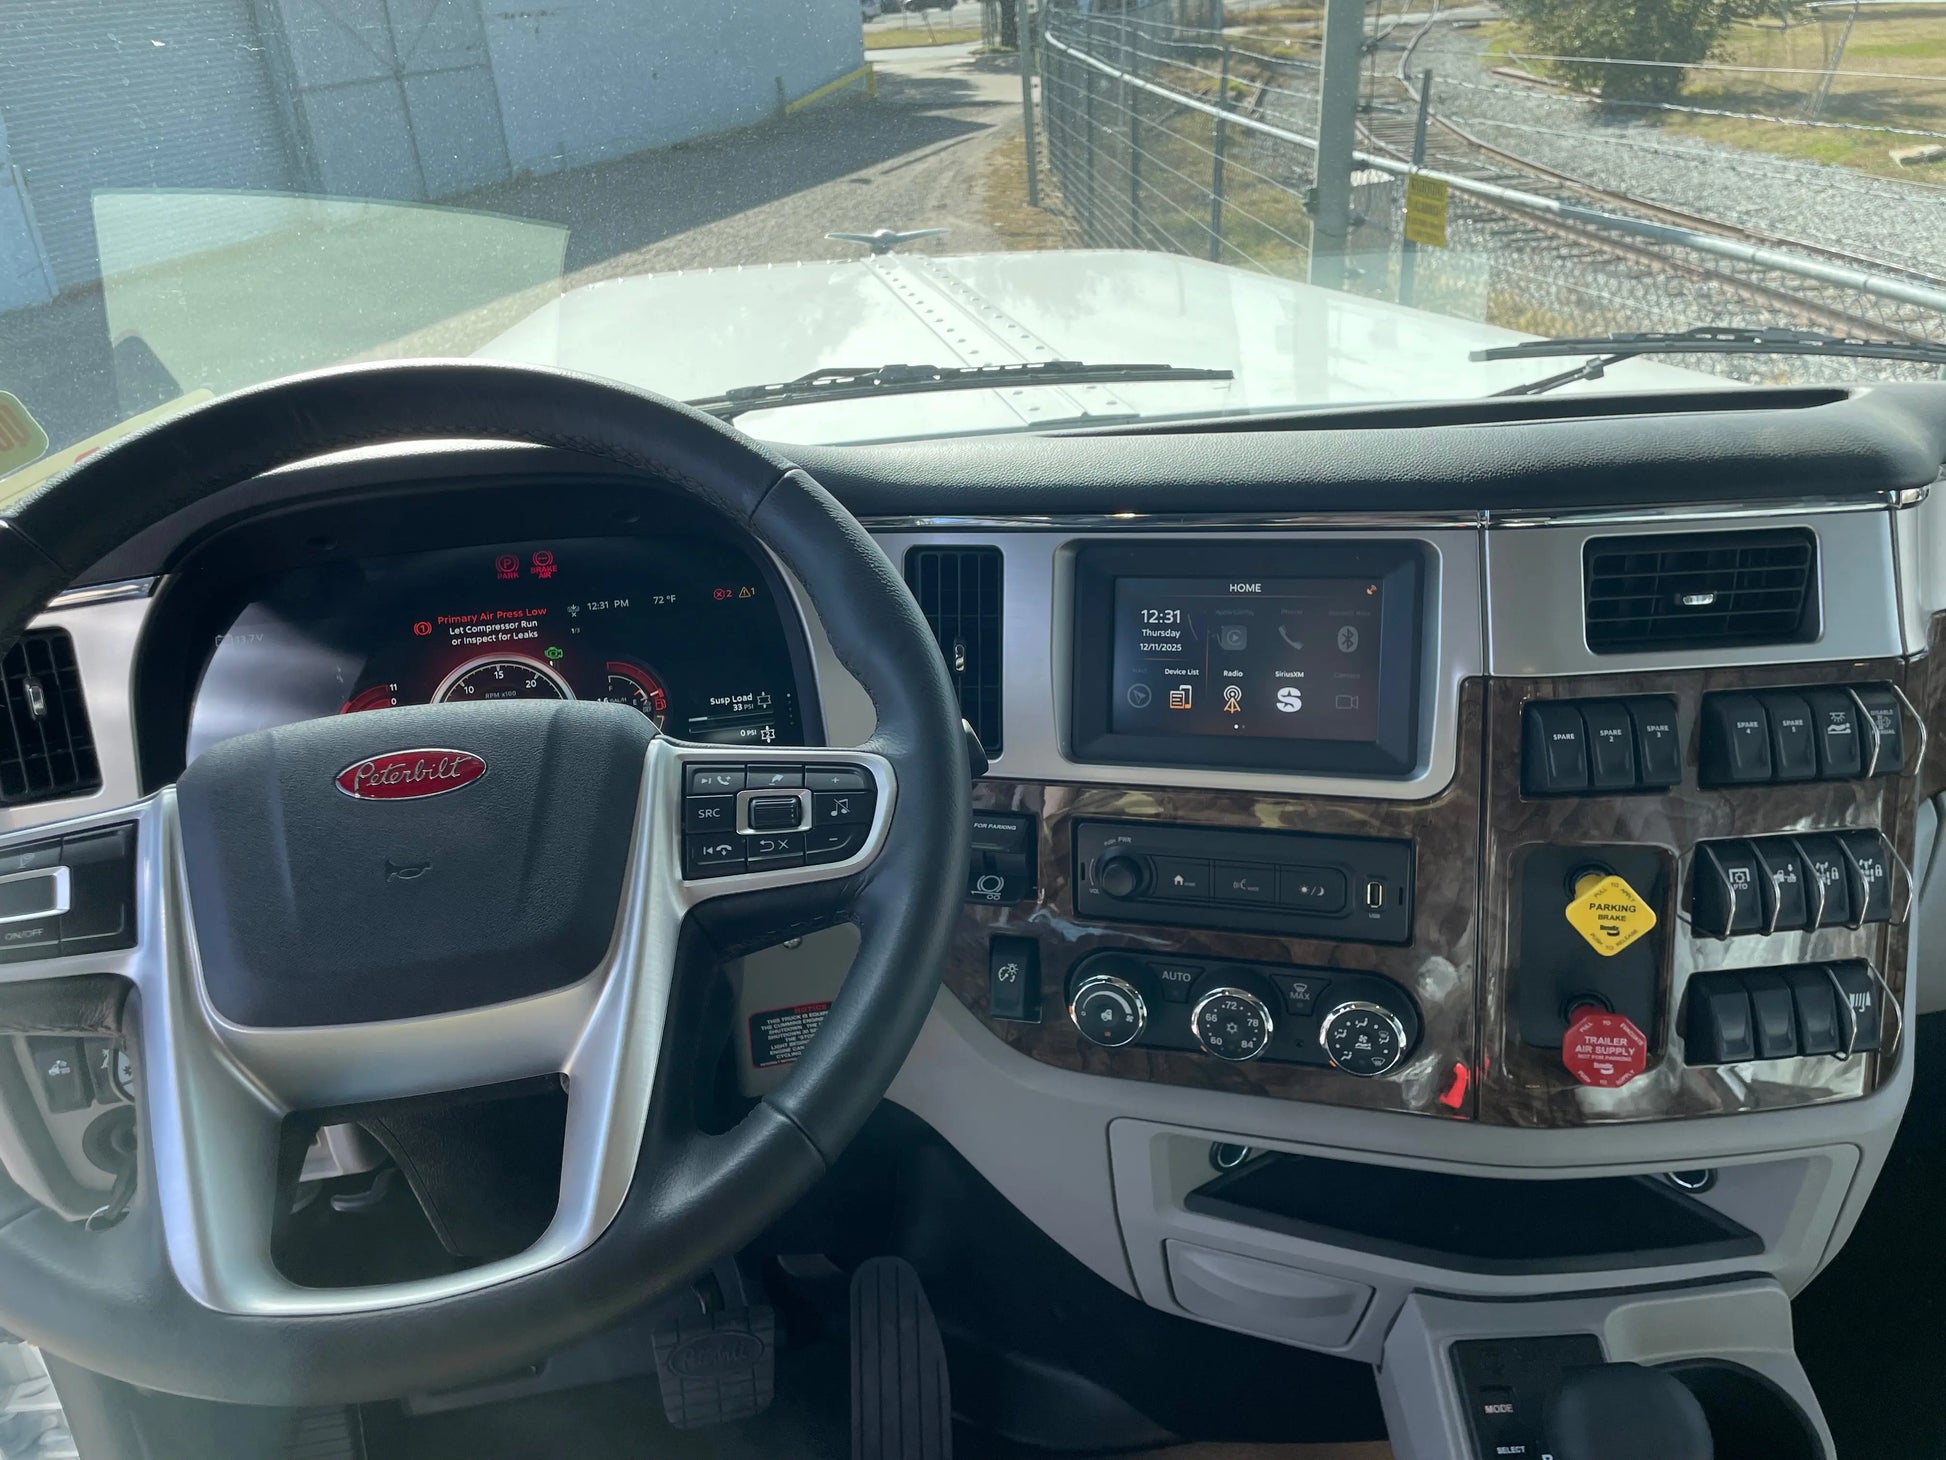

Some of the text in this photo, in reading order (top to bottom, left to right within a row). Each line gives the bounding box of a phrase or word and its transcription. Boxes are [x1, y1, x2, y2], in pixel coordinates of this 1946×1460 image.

[530, 565, 558, 575] BRAKE
[497, 571, 519, 580] PARK
[1229, 583, 1262, 593] HOME
[726, 590, 733, 598] 2
[586, 599, 629, 611] 12:31 PM
[653, 596, 665, 605] 72
[437, 607, 548, 625] Primary Air Press Low
[1141, 609, 1181, 624] 12:31
[449, 619, 539, 636] Let Compressor Run
[451, 630, 539, 647] or Inspect for Leaks
[1142, 629, 1181, 639] Thursday
[1139, 643, 1182, 652] 12/11/2025
[493, 671, 505, 680] 15
[1164, 668, 1187, 676] Device
[1223, 670, 1244, 678] Radio
[1275, 670, 1305, 678] SiriusXM
[389, 684, 398, 692] 11
[525, 679, 538, 689] 20
[464, 685, 476, 695] 10
[485, 690, 517, 700] RPM x100
[710, 693, 753, 706] Susp Load
[733, 703, 743, 711] 33
[1736, 721, 1759, 729] SPARE
[1782, 719, 1804, 727] SPARE
[1599, 728, 1622, 737] SPARE
[1646, 724, 1669, 732] SPARE
[740, 729, 746, 737] 0
[1552, 733, 1575, 741] SPARE
[354, 757, 472, 797] Peterbilt
[698, 808, 721, 818] SRC
[1589, 903, 1637, 913] PARKING
[1597, 914, 1627, 922] BRAKE
[5, 928, 44, 941] ON/OFF
[1161, 970, 1191, 983] AUTO
[1289, 991, 1310, 1001] MAX
[1225, 1001, 1238, 1010] 72
[1205, 1013, 1218, 1022] 66
[1247, 1019, 1260, 1027] 78
[1210, 1036, 1223, 1046] 60
[1241, 1040, 1254, 1049] 84
[1585, 1036, 1627, 1046] TRAILER
[1575, 1045, 1635, 1056] AIR SUPPLY
[1485, 1404, 1513, 1414] MODE
[1496, 1446, 1525, 1454] SELECT
